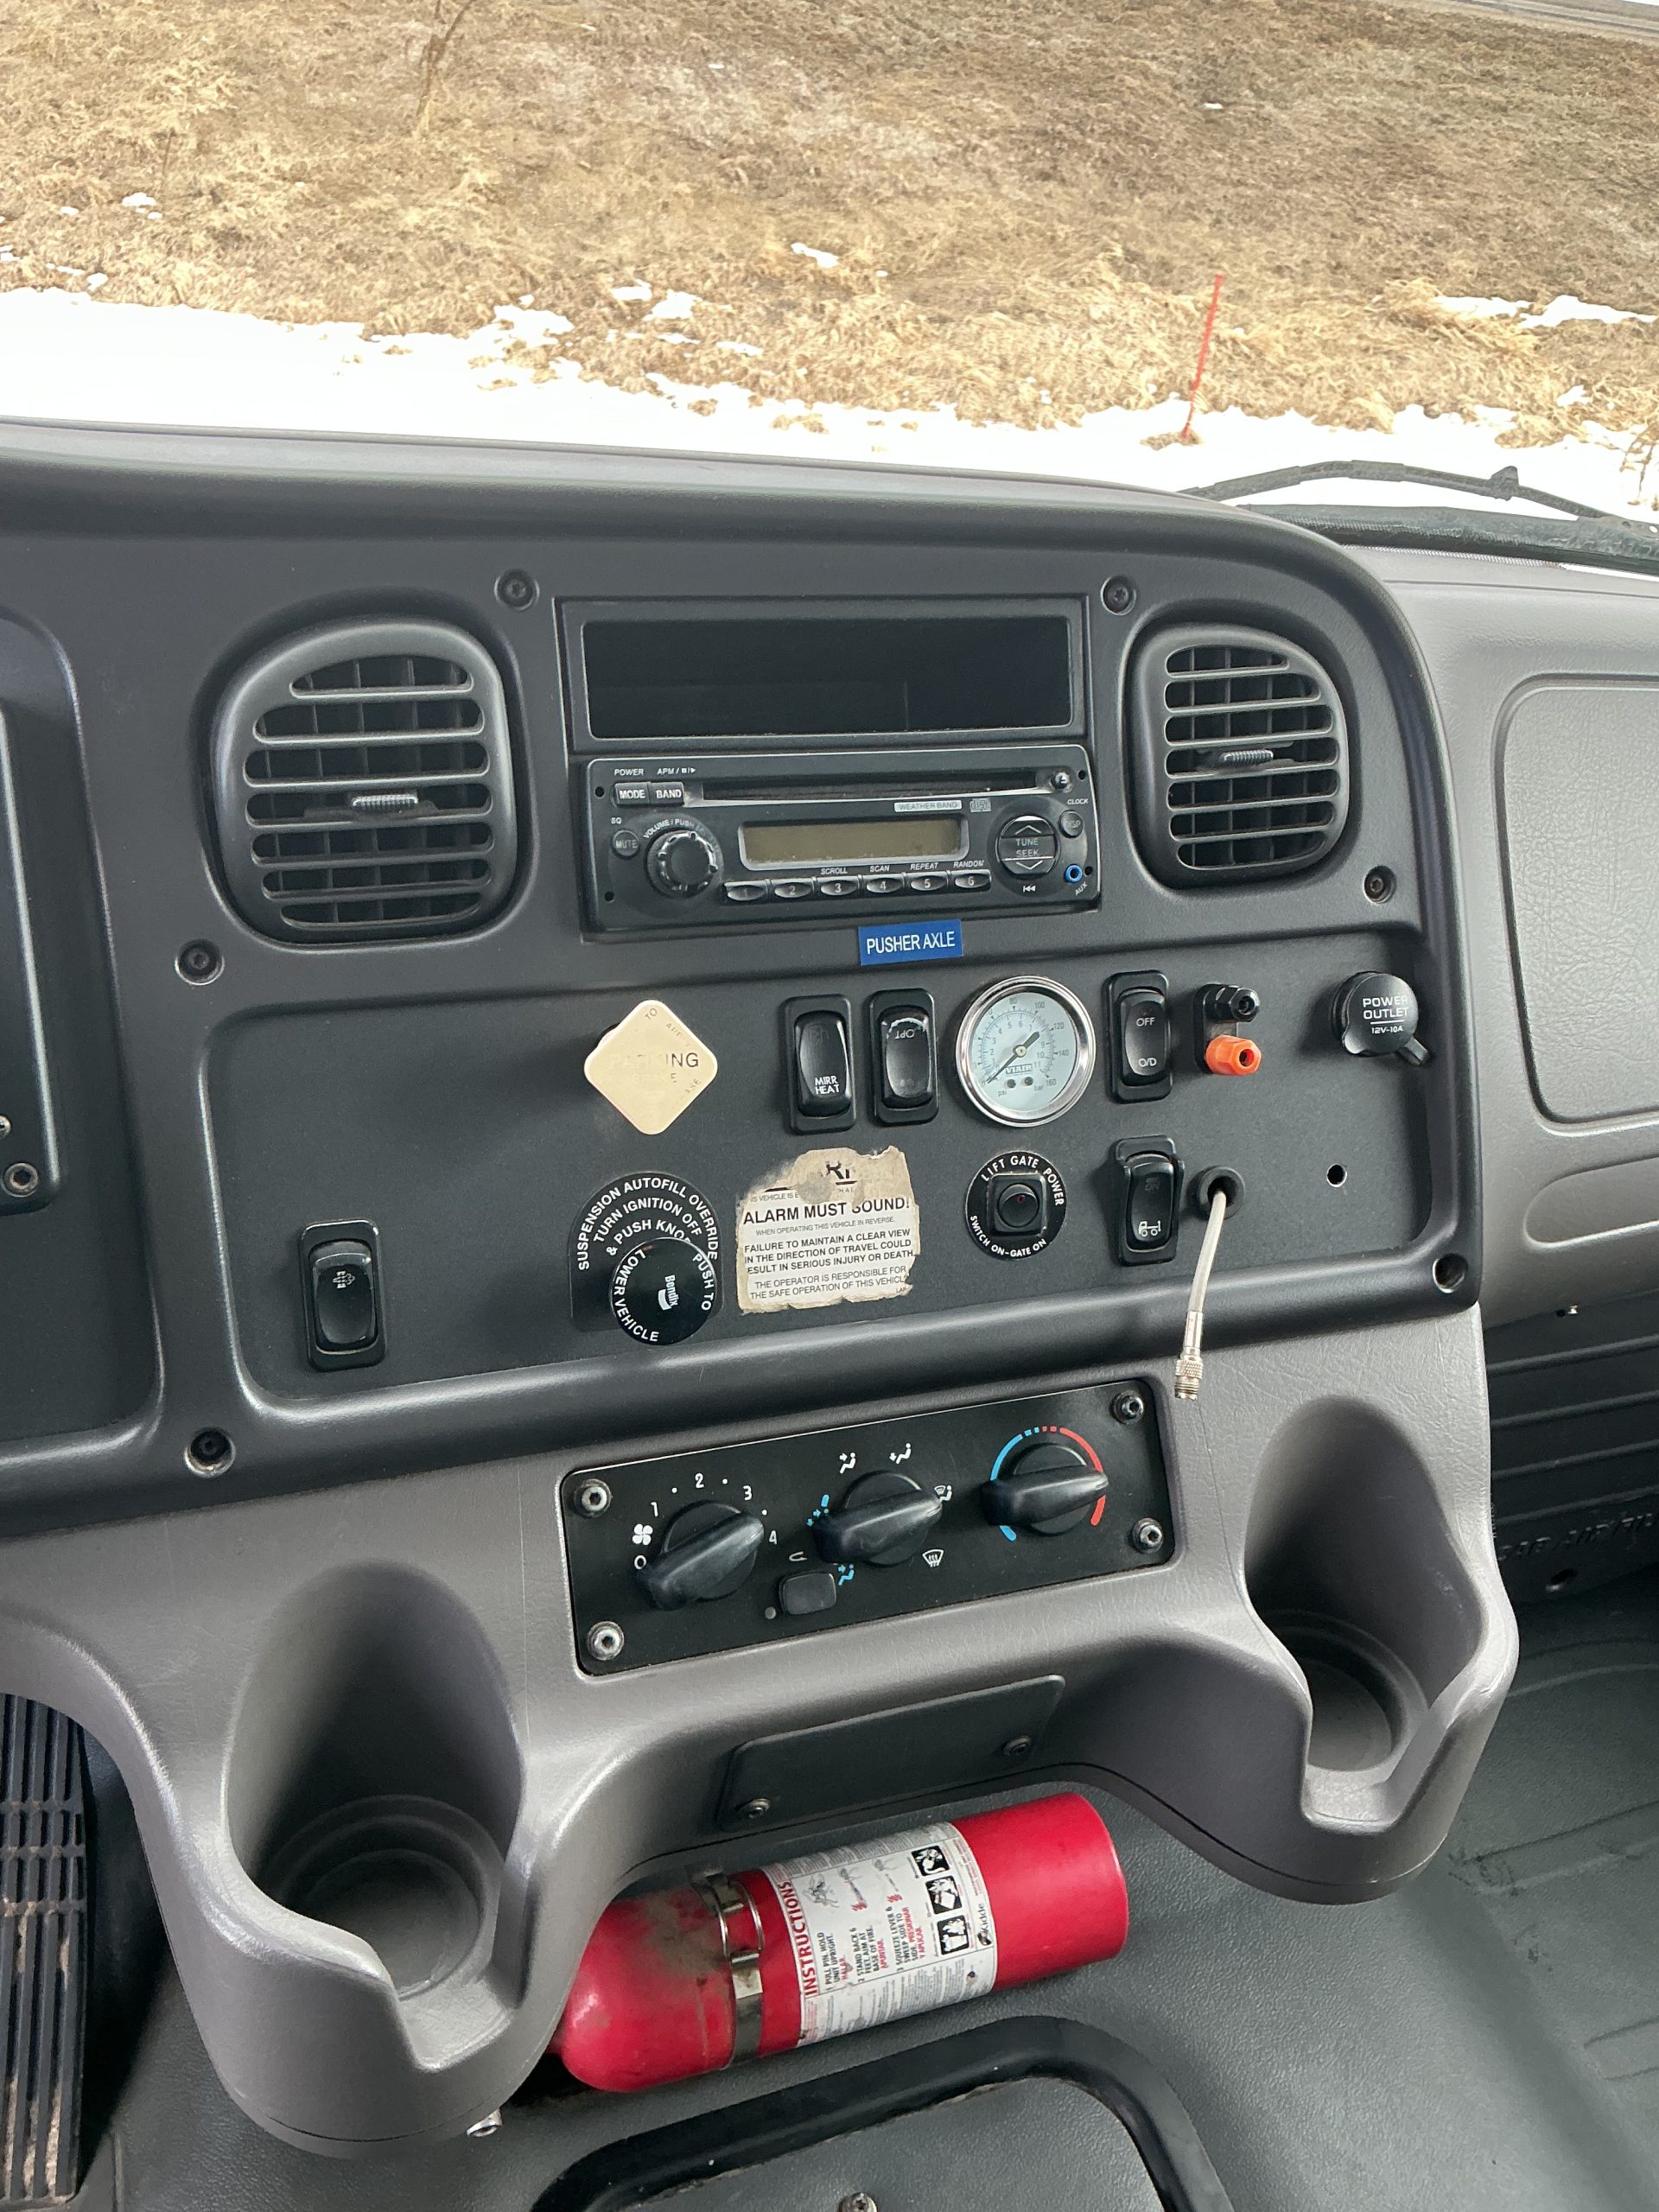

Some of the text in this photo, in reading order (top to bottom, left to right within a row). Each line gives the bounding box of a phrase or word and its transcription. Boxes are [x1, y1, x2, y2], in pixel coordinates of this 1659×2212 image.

[620, 790, 645, 799] MODE
[657, 789, 682, 799] BAND
[899, 802, 935, 810] WEATHER
[643, 819, 670, 839] VOLUME
[616, 839, 637, 849] MUTE
[835, 883, 842, 893] 3
[880, 881, 887, 891] 4
[924, 879, 931, 888] 5
[968, 876, 975, 886] 6
[1075, 882, 1089, 896] AUX
[789, 885, 796, 895] 2
[867, 931, 956, 955] PUSHER AXLE
[1363, 995, 1408, 1007] POWER
[645, 1007, 658, 1020] TO
[1363, 1007, 1409, 1020] OUTLET
[1136, 1017, 1154, 1027] OFF
[1371, 1026, 1403, 1034] 12V-10A
[1006, 1065, 1032, 1074] VIAIR
[1138, 1058, 1157, 1067] O/D
[815, 1075, 838, 1085] MIRR
[816, 1084, 840, 1095] HEAT
[981, 1155, 1065, 1206] LIFT GATE POWER
[760, 1193, 785, 1202] VEHICLE
[593, 1198, 702, 1243] TURN IGNITION OFF
[743, 1207, 798, 1224] ALARM
[804, 1202, 847, 1218] MUST
[577, 1178, 718, 1270] SUSPENSION AUTOFILL OVERRIDE
[777, 1224, 813, 1235] OPERATING
[830, 1220, 856, 1229] VEHICLE
[606, 1246, 618, 1256] &
[613, 1219, 652, 1245] PUSH
[745, 1229, 911, 1253] FAILURE TO MAINTAIN A CLEAR VIEW
[970, 1216, 990, 1247] SWITCH
[1033, 1238, 1047, 1251] ON
[756, 1254, 774, 1262] THE
[777, 1248, 826, 1261] DIRECTION
[842, 1243, 879, 1253] TRAVEL
[880, 1239, 912, 1249] COULD
[791, 1258, 831, 1270] SERIOUS
[834, 1255, 866, 1265] INJURY
[692, 1254, 714, 1311] PUSH TO
[755, 1281, 772, 1289] THE
[773, 1274, 820, 1287] OPERATOR
[831, 1268, 888, 1281] RESPONSIBLE
[890, 1266, 906, 1274] FOR
[613, 1249, 659, 1341] LOWER VEHICLE
[664, 1274, 678, 1306] Bendix
[750, 1291, 767, 1300] THE
[768, 1288, 791, 1298] SAFE
[792, 1282, 841, 1295] OPERATION
[855, 1279, 874, 1287] THIS
[695, 1472, 704, 1489] 2
[742, 1485, 753, 1501] 3
[651, 1502, 658, 1517] 1
[769, 1530, 778, 1545] 4
[887, 1913, 898, 1935] LEVER
[978, 1904, 989, 1934] Kidde
[778, 1882, 819, 1997] INSTRUCTIONS
[817, 1932, 827, 1952] HOLD
[851, 1933, 861, 1952] BACK
[859, 1932, 867, 1941] AT
[896, 1913, 911, 1963] SWEEP SIDE TO
[870, 1944, 877, 1953] OF
[893, 1936, 904, 1965] SQUEEZE
[855, 1954, 865, 1976] STAND
[871, 1955, 880, 1971] BASE
[832, 1967, 841, 1983] UNIT
